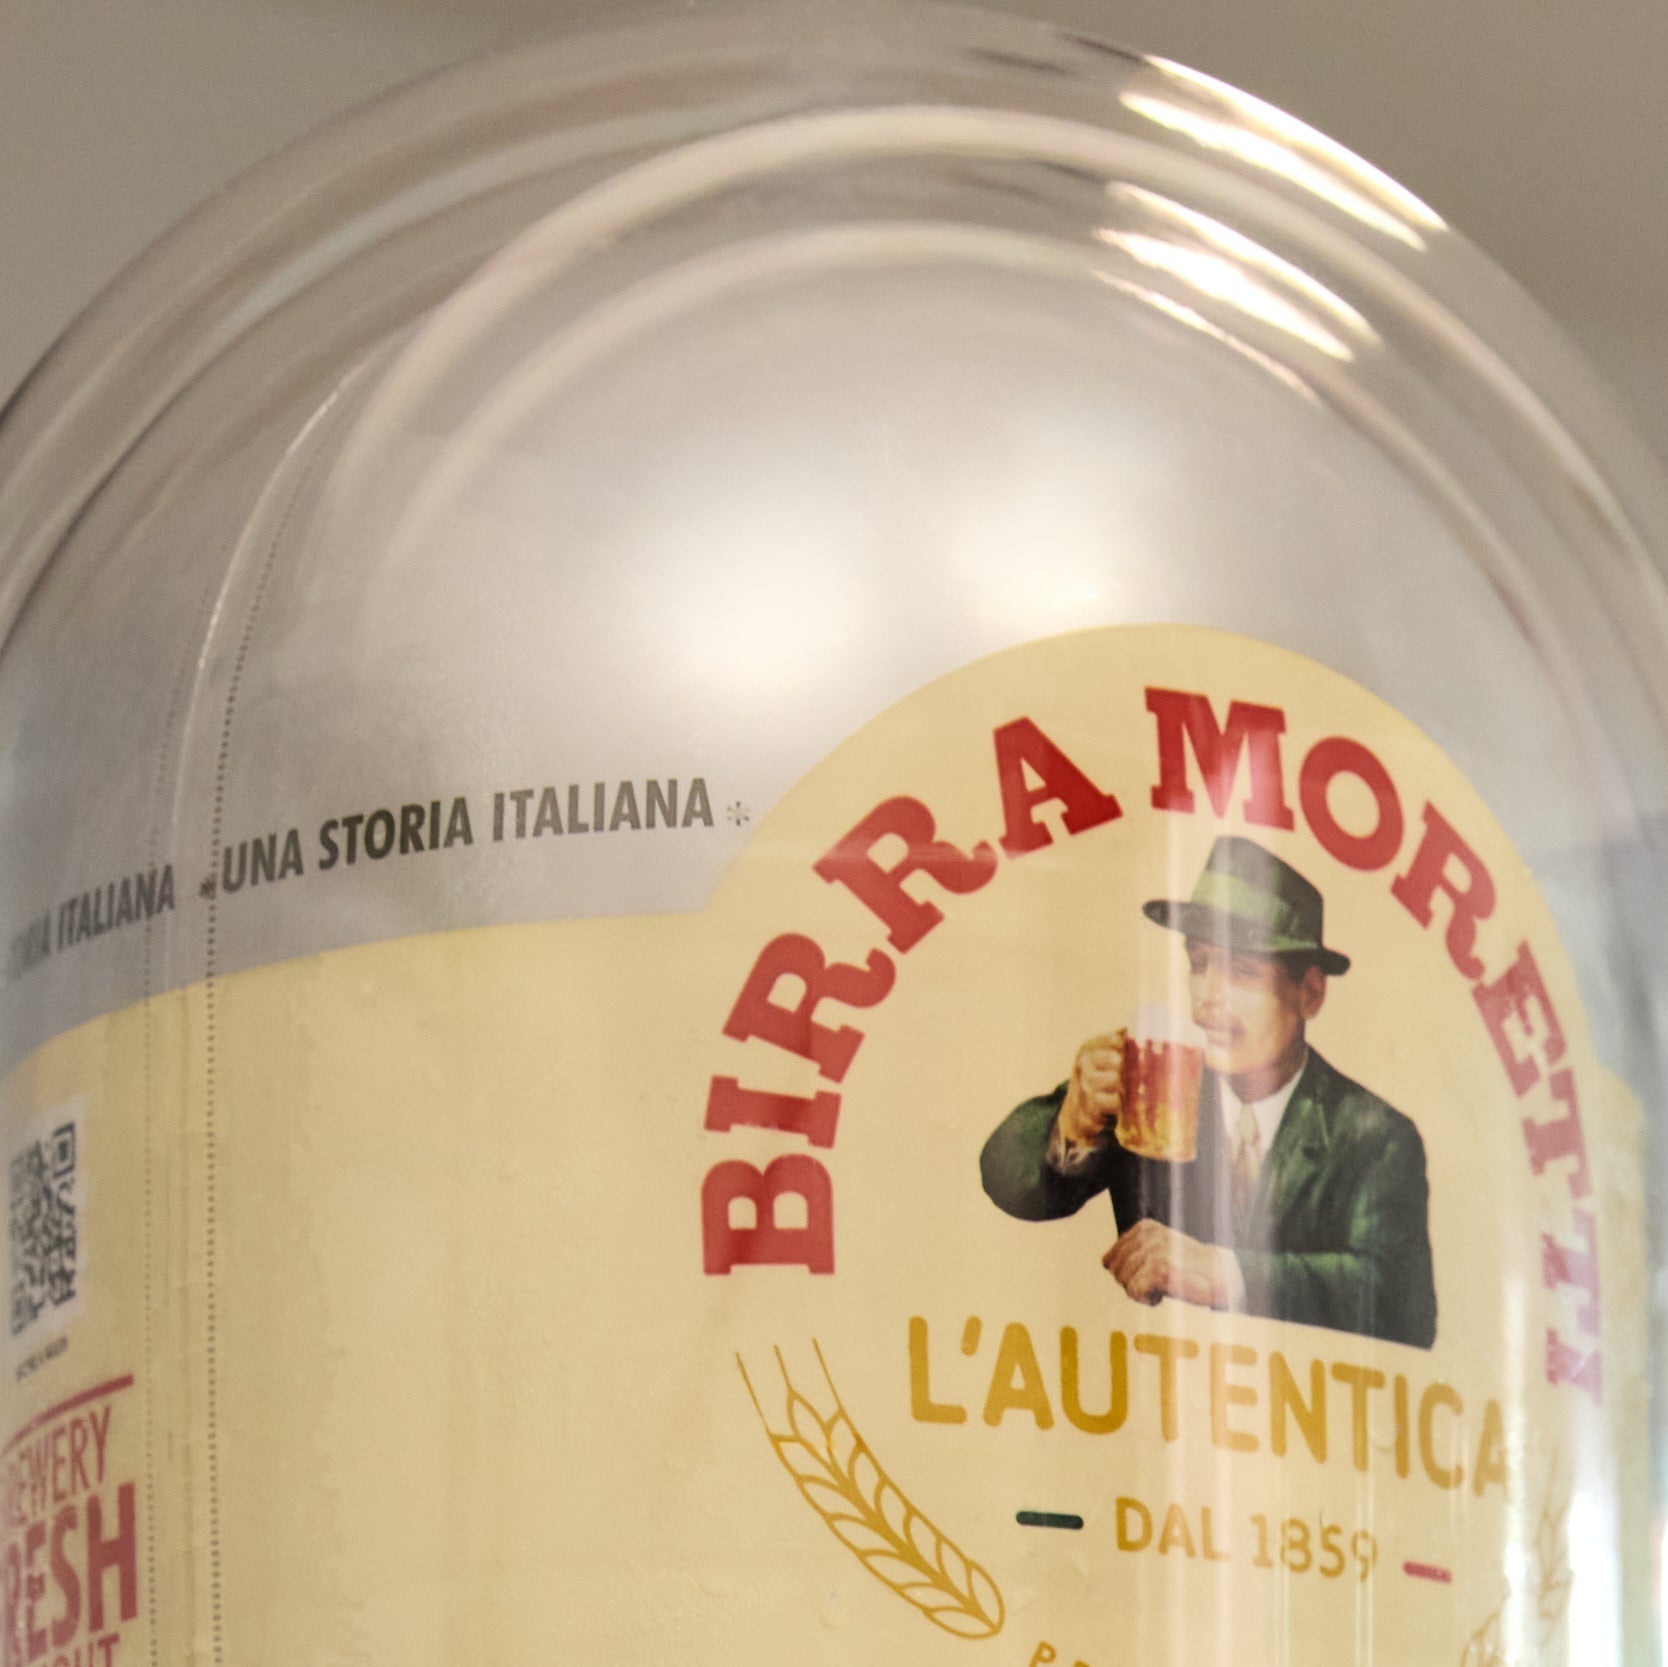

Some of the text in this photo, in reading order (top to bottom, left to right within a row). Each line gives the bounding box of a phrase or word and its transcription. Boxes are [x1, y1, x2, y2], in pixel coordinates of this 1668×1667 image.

[222, 829, 303, 893] UNA
[317, 797, 473, 871] STORIA
[492, 778, 714, 842] ITALIANA
[700, 686, 1602, 1406] BIRRA MORETTI
[908, 1315, 1514, 1504] L'AUTENTICA
[1114, 1496, 1378, 1583] DAL 1859
